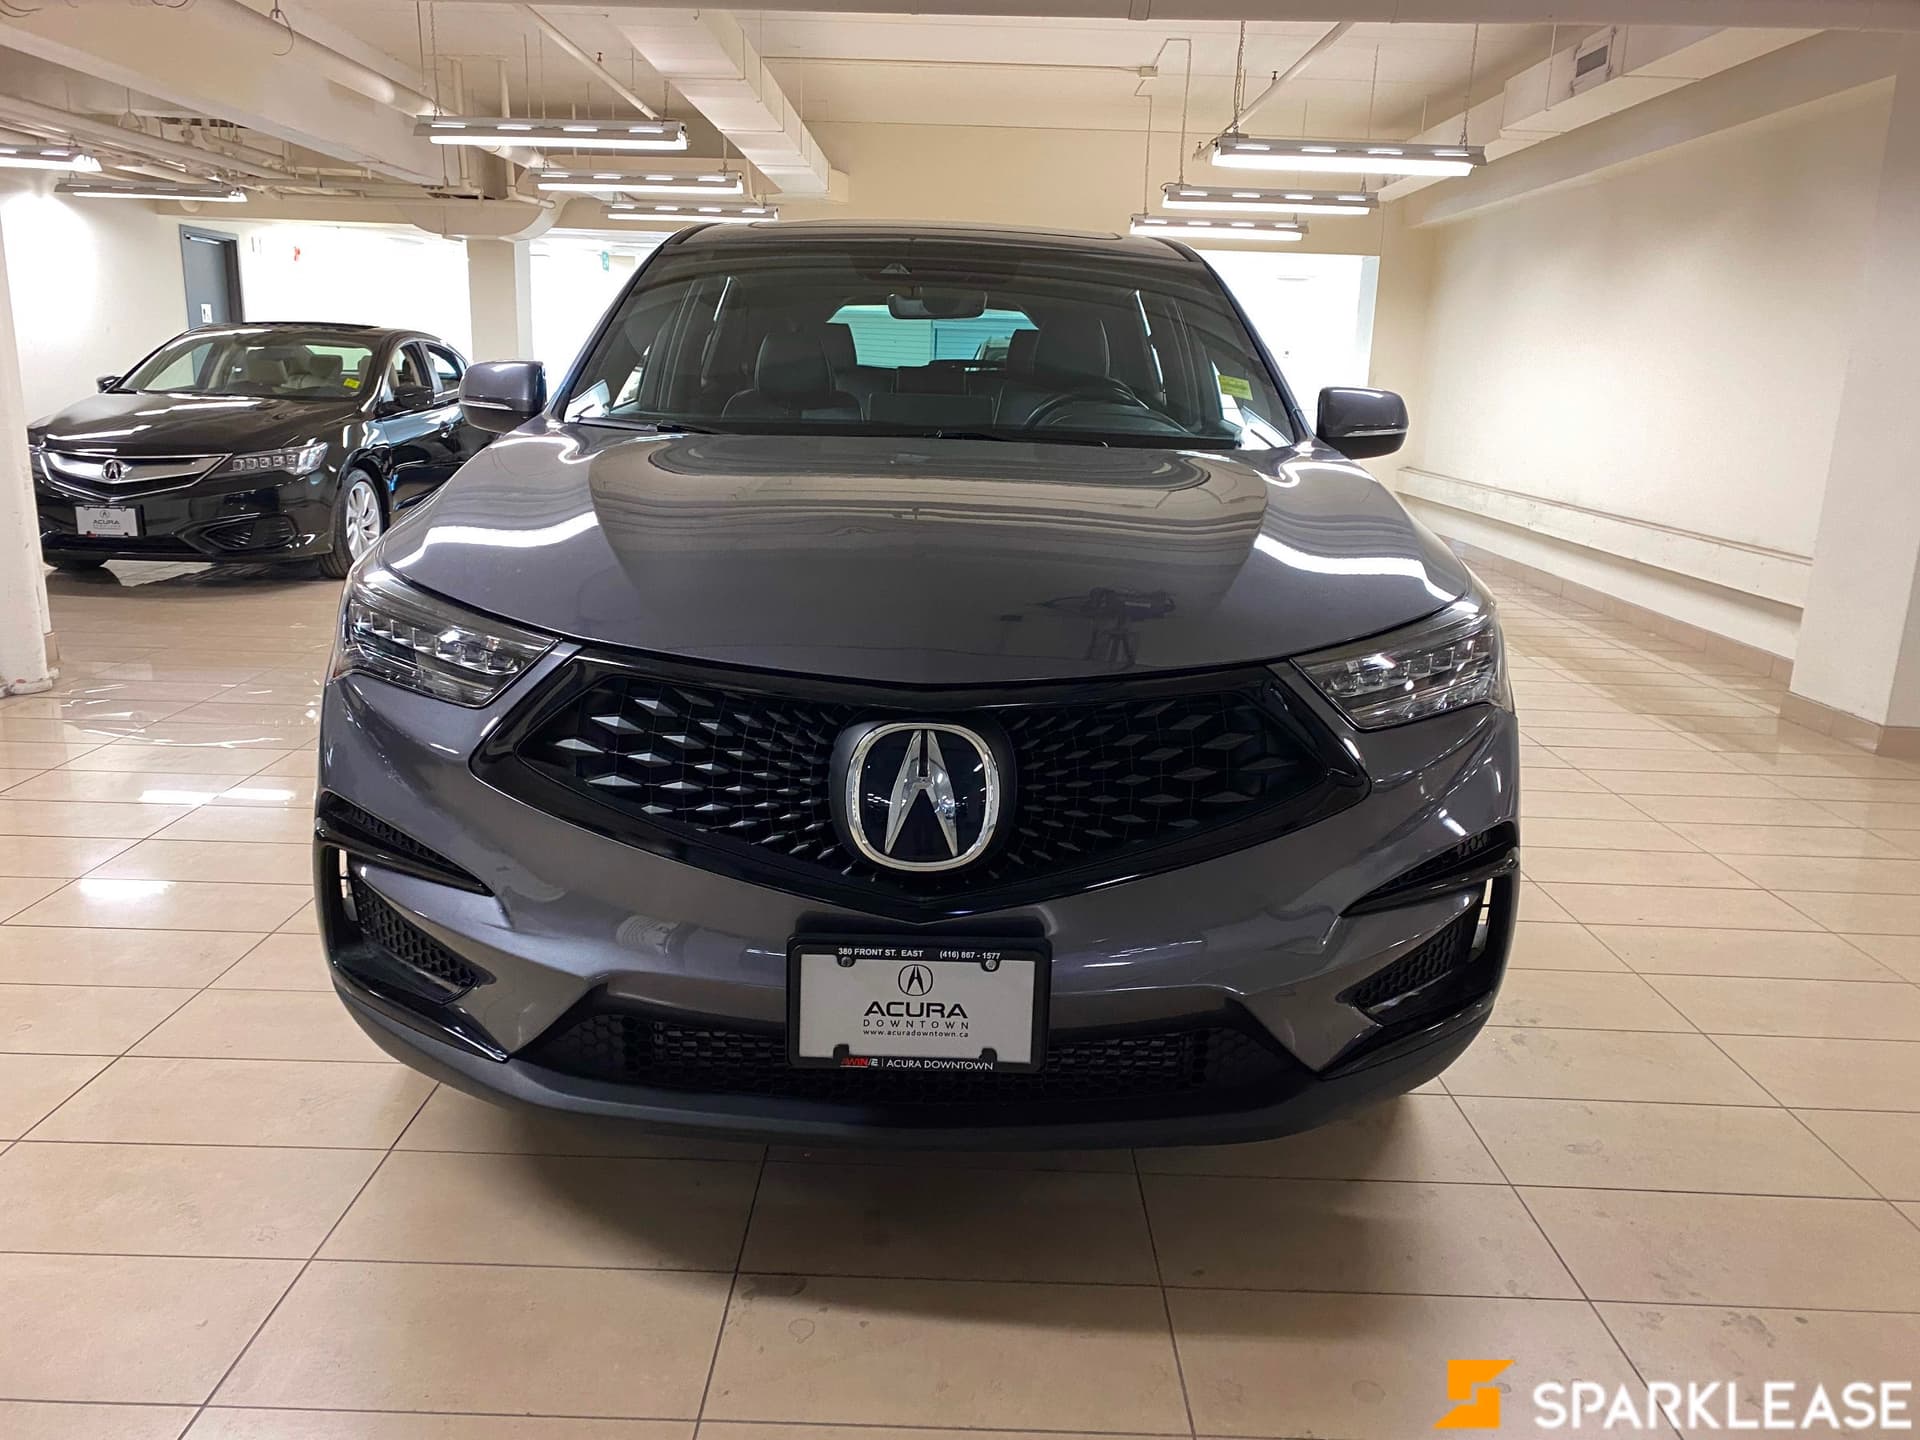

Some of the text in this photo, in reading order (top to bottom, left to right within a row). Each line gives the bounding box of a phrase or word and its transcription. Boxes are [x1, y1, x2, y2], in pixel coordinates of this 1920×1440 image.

[854, 948, 883, 956] FRONT
[884, 949, 897, 957] ST.
[901, 949, 924, 957] EAST
[939, 950, 960, 960] (416)
[982, 952, 1001, 960] 1577
[863, 1001, 969, 1019] ACURA
[863, 1019, 969, 1030] DOWNTOWN
[863, 1030, 969, 1038] www.acuradowntown.ca
[886, 1059, 922, 1068] ACURA
[924, 1060, 994, 1070] DOWNTOWN
